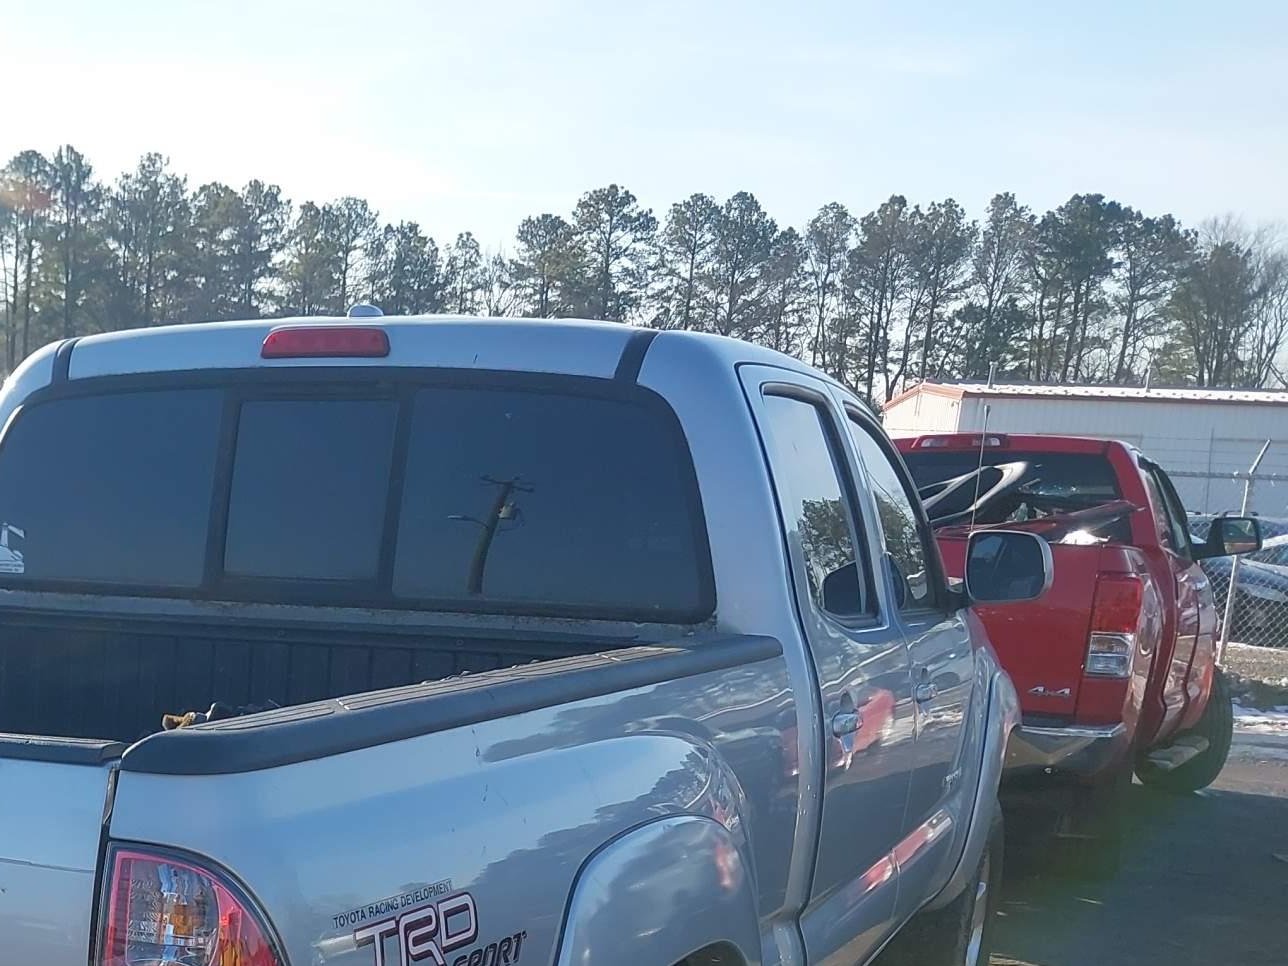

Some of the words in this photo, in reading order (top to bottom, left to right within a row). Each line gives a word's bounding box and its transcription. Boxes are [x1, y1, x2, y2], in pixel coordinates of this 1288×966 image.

[333, 911, 367, 929] TOYOTA
[368, 900, 399, 918] RACING
[400, 879, 454, 908] DEVELOPMENT
